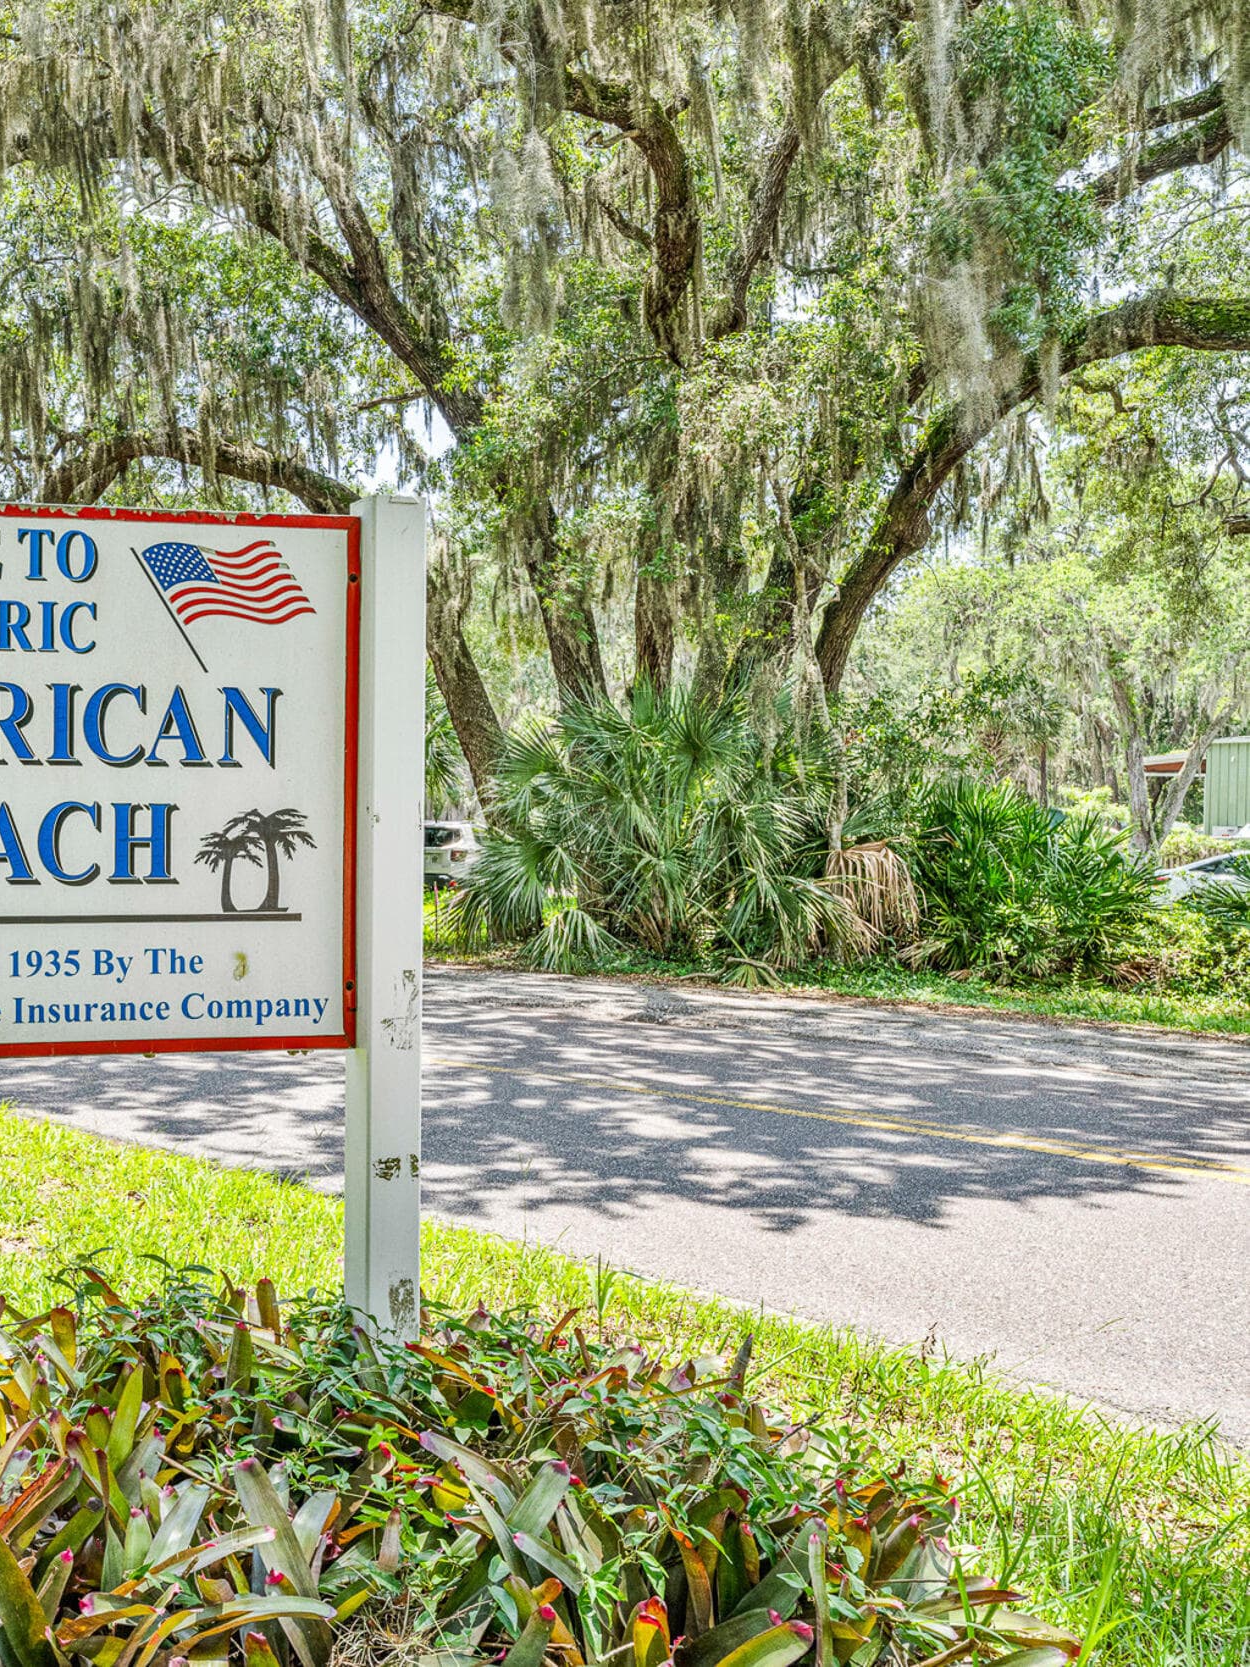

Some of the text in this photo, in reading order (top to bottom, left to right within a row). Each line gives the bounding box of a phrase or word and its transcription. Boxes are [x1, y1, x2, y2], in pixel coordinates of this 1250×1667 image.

[18, 528, 99, 584] TO
[9, 949, 80, 978] 1935
[92, 949, 134, 984] By
[143, 948, 204, 975] The
[13, 997, 170, 1025] Insurance
[181, 992, 330, 1026] Company
